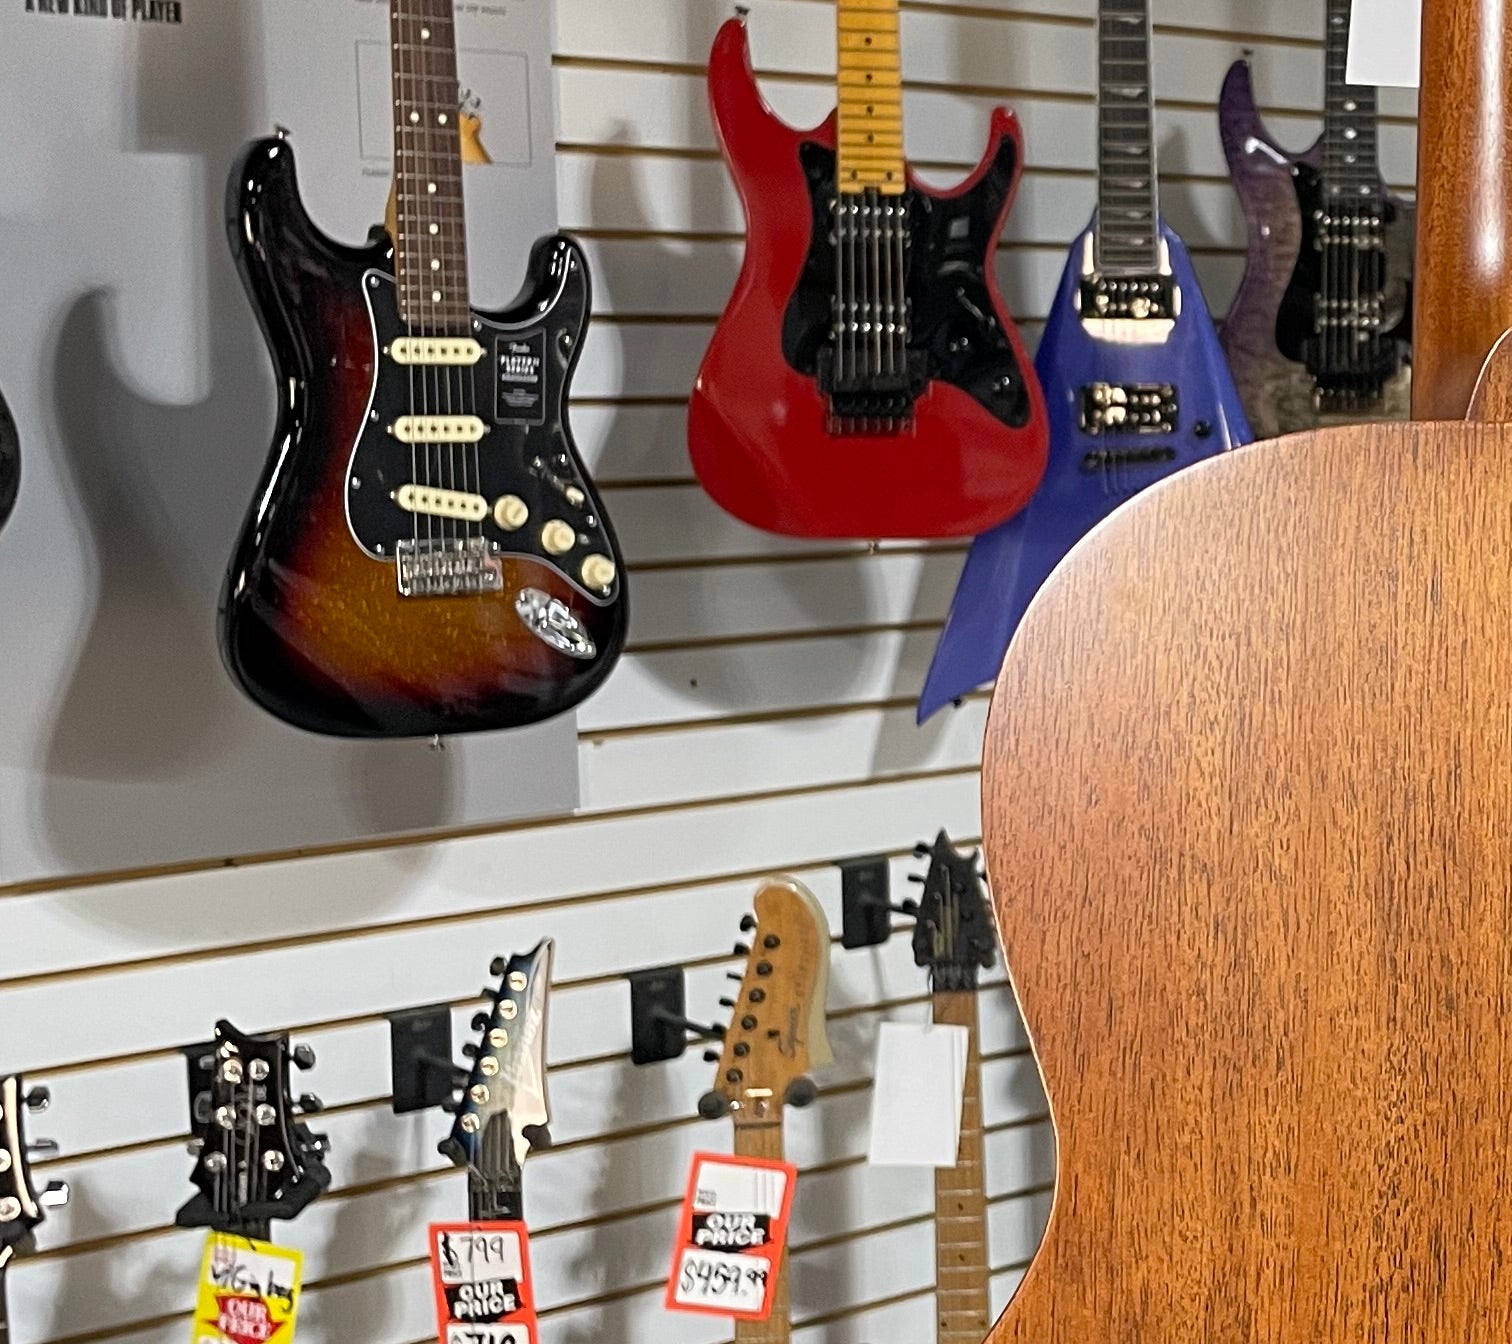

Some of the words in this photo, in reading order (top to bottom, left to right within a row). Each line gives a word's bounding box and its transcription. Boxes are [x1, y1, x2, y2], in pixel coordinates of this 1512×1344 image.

[706, 1212, 756, 1230] OUR
[695, 1227, 766, 1246] PRICE
[458, 1280, 505, 1301] OUR
[228, 1297, 268, 1322] OUR
[453, 1293, 517, 1320] PRICE
[217, 1314, 272, 1341] PRICE
